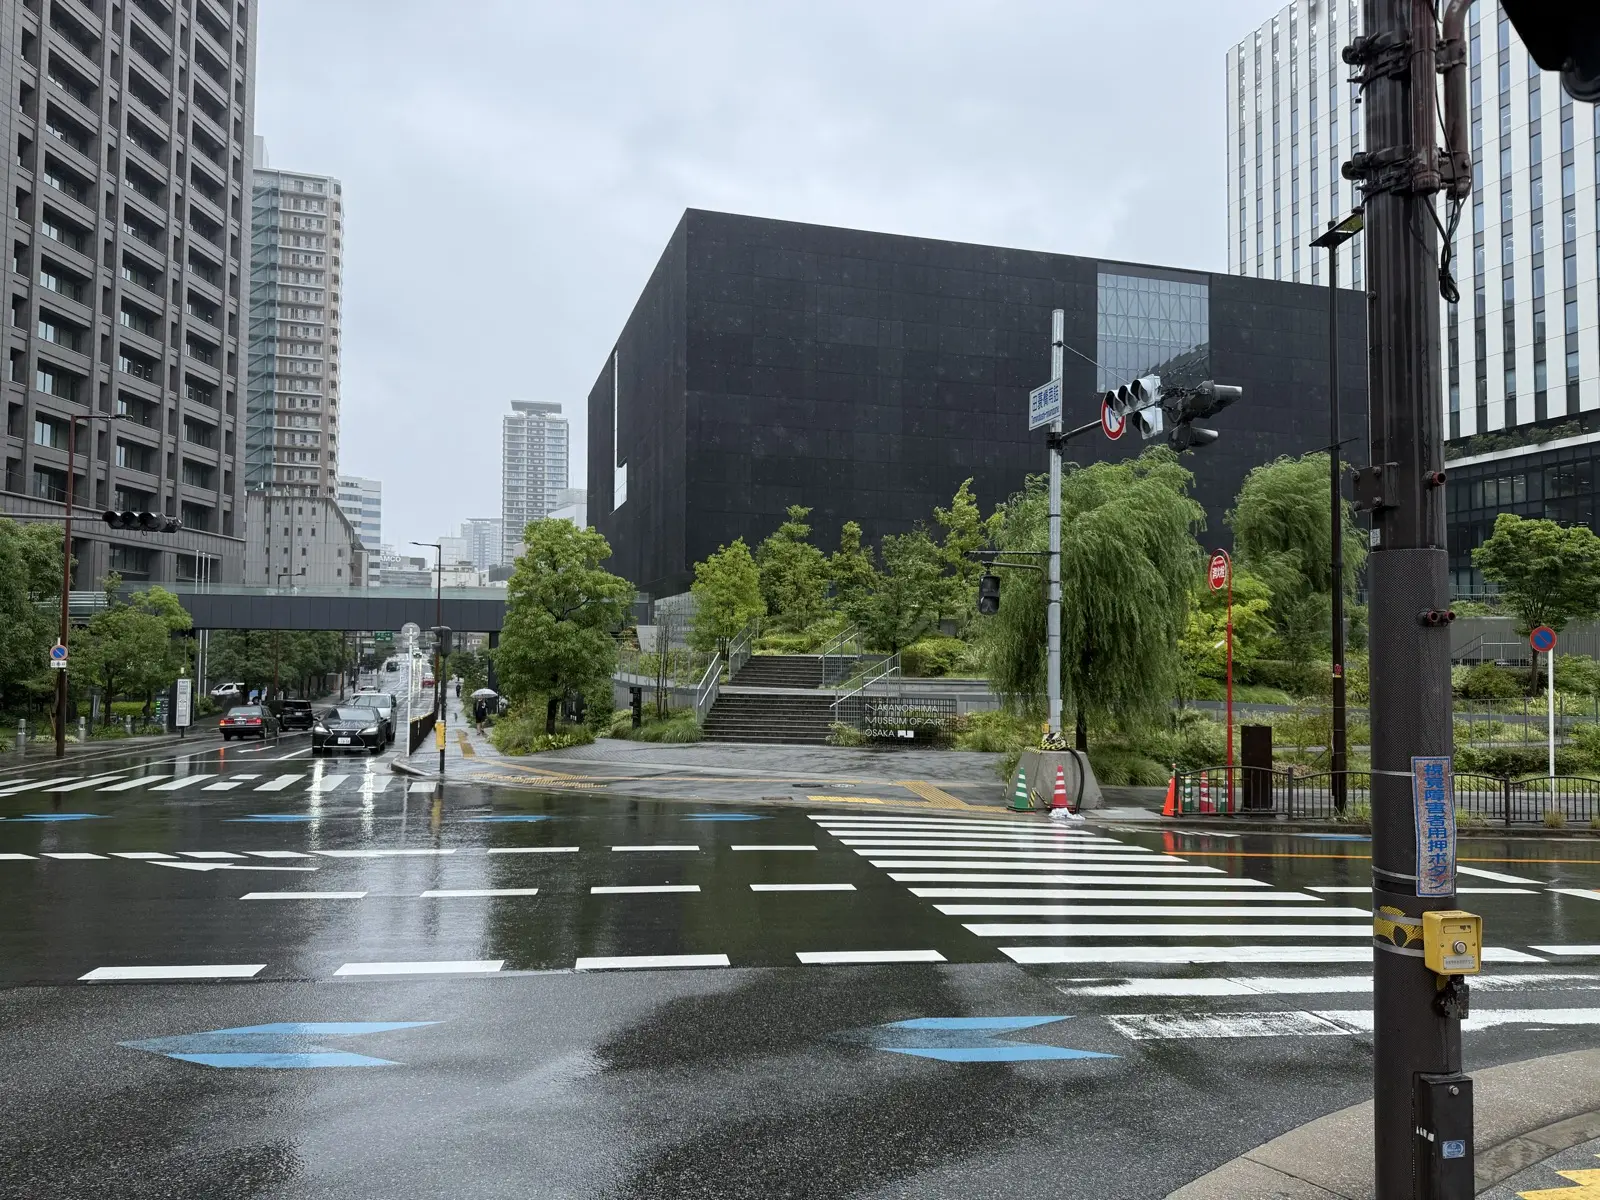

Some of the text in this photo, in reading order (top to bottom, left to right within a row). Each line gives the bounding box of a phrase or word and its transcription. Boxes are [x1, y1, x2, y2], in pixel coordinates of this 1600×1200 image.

[865, 703, 939, 713] NAKANOSHIMA
[865, 716, 907, 725] MUSEUM
[909, 717, 921, 725] OF
[865, 728, 895, 737] OSAKA
[1423, 763, 1448, 889] 視覚障害者用押ボタン
